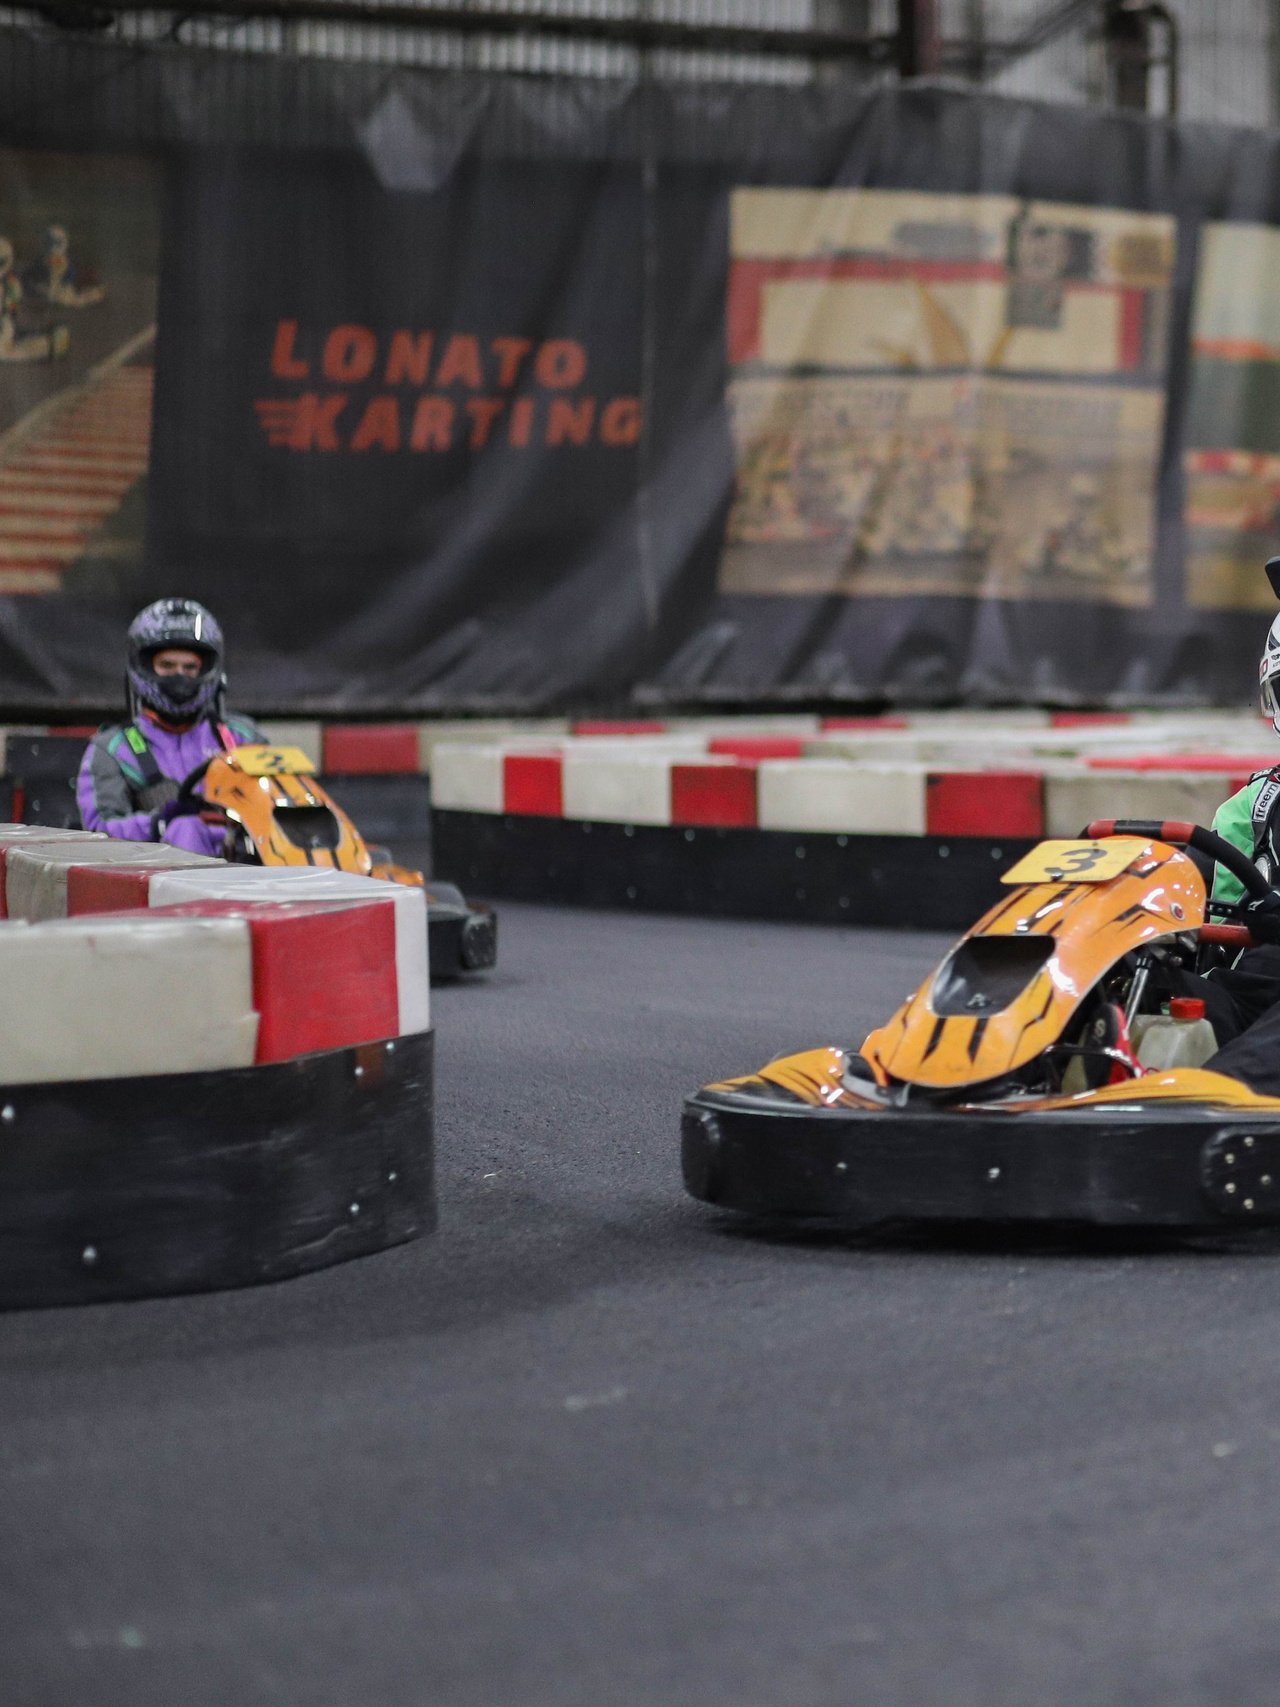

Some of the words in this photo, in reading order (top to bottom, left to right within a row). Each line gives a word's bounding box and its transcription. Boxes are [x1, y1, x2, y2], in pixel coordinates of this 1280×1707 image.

[271, 320, 588, 387] LONATO
[284, 393, 642, 452] KARTING
[1256, 784, 1277, 817] freem
[1044, 848, 1108, 874] 3
